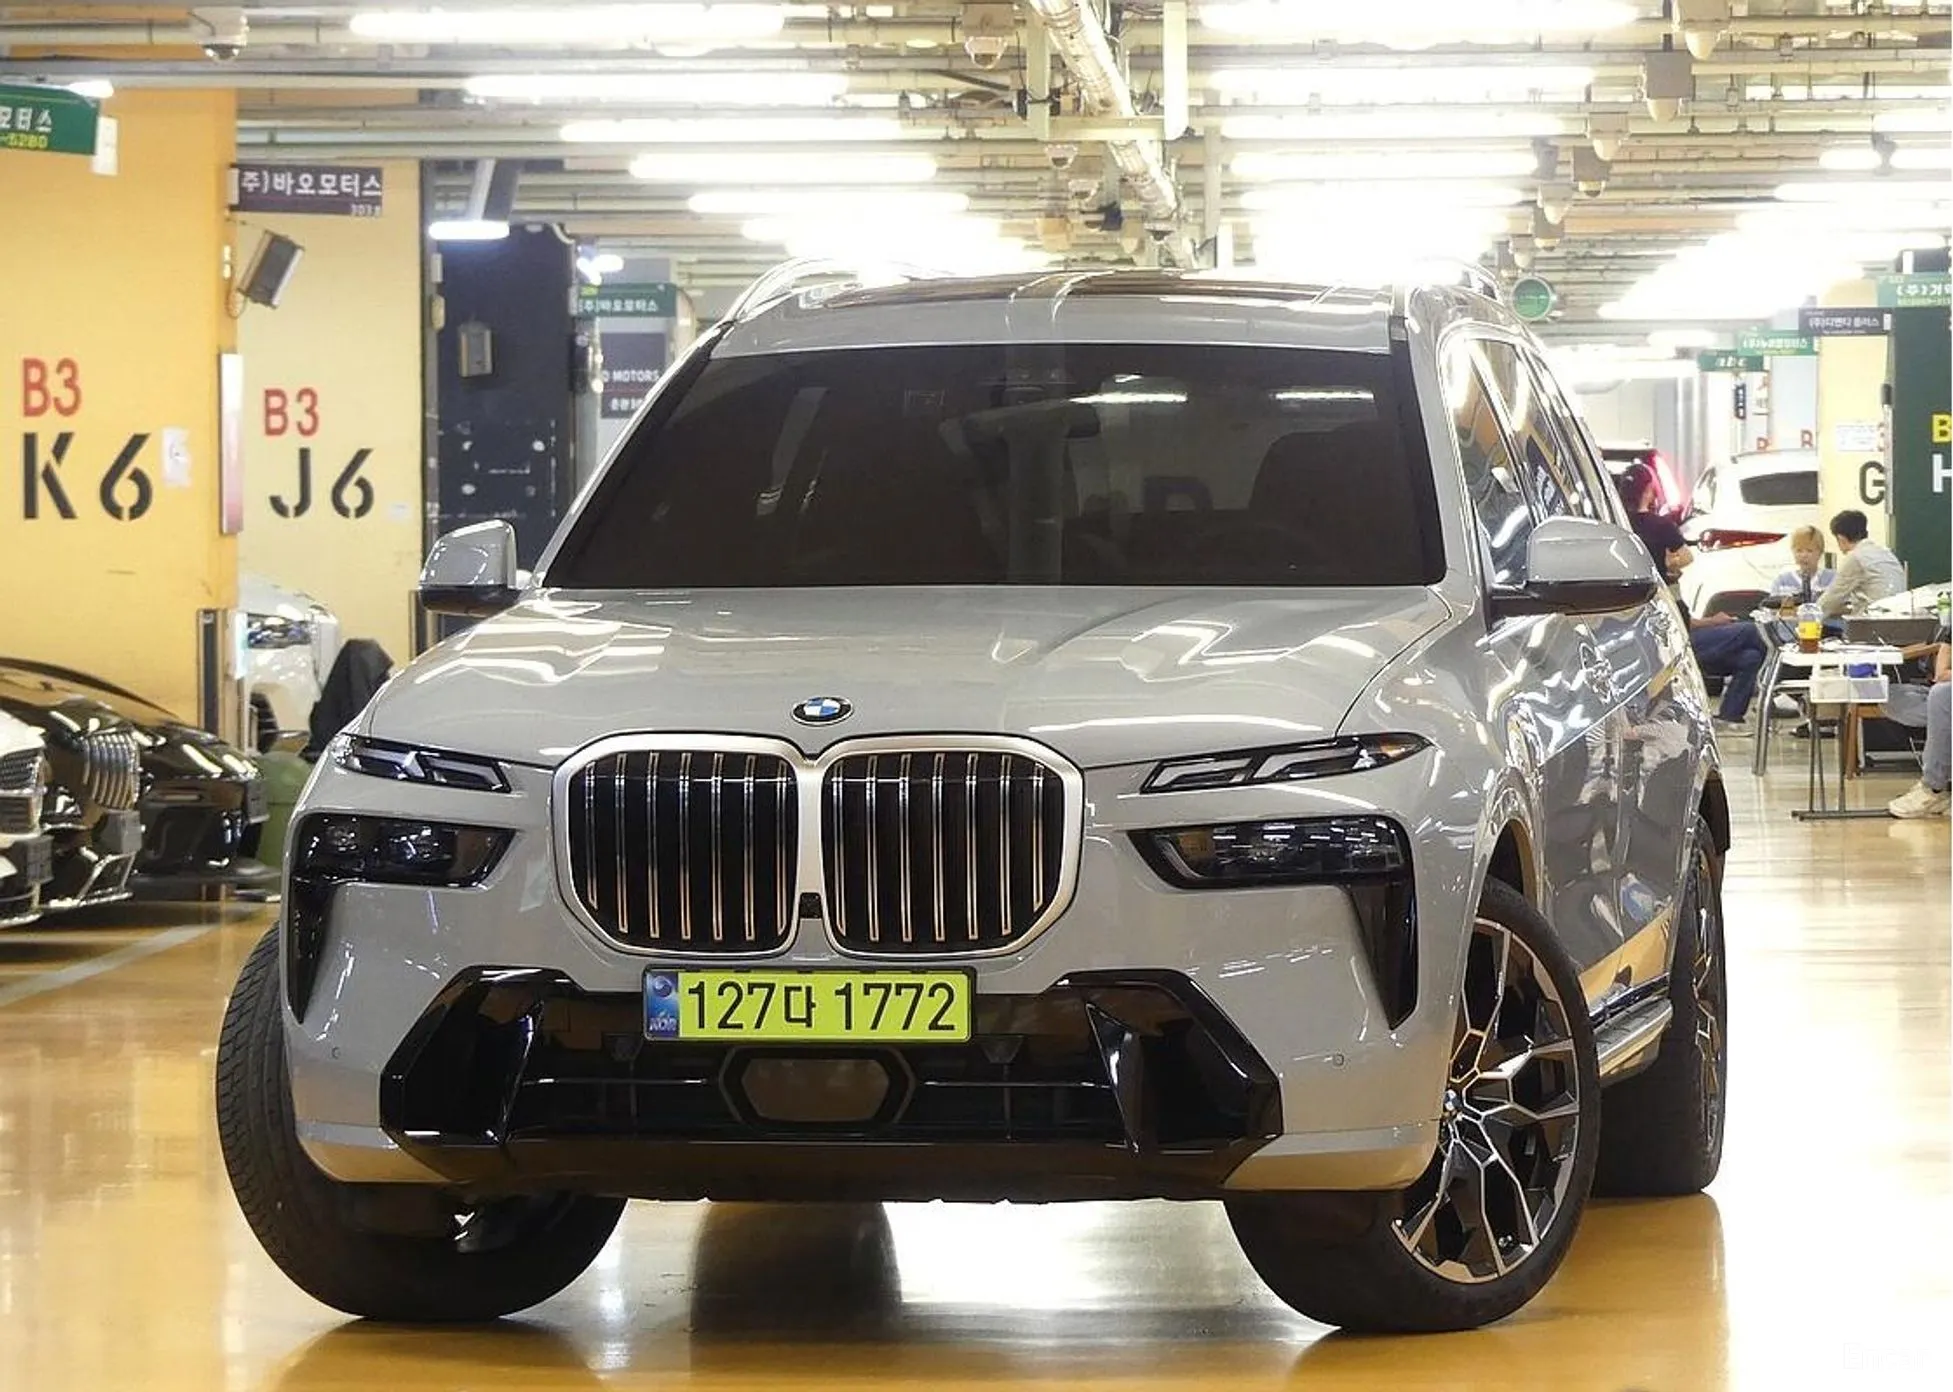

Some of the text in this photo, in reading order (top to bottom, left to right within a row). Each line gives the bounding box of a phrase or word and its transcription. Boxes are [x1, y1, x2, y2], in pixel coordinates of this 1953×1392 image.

[22, 358, 82, 417] B3
[612, 369, 660, 382] MOTORS
[264, 388, 319, 437] B3
[688, 981, 956, 1031] 127다 1772
